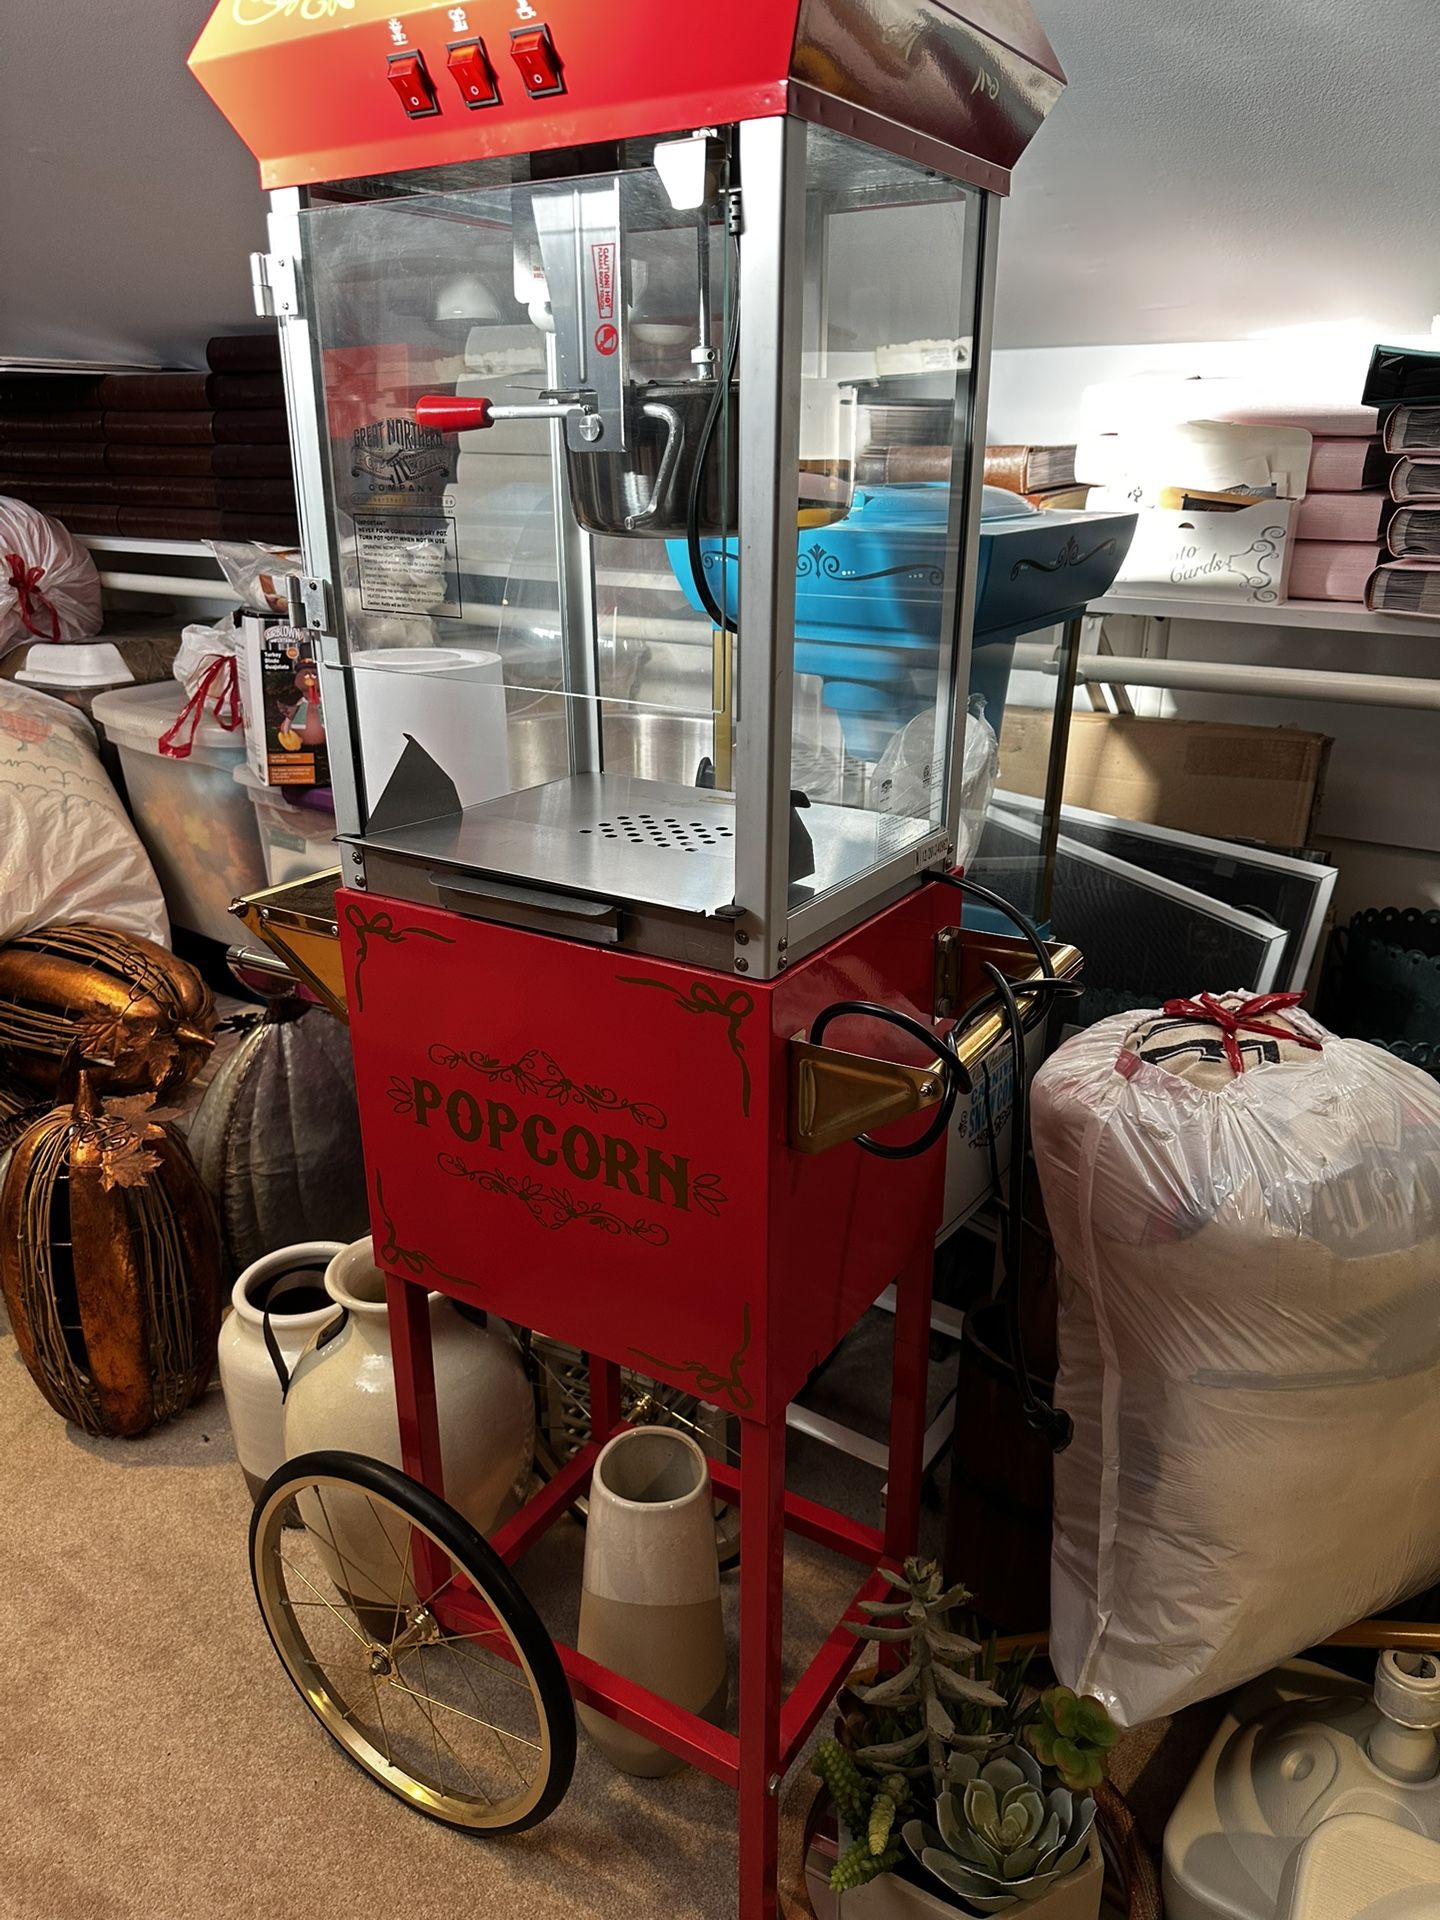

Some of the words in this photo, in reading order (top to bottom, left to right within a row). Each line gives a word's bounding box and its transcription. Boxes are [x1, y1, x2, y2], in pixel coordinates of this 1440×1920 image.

[353, 422, 385, 448] GREAT
[386, 418, 443, 450] NORTHERN
[368, 484, 433, 492] COMPANY
[1170, 552, 1222, 583] Cards
[411, 1076, 692, 1213] POPCORN
